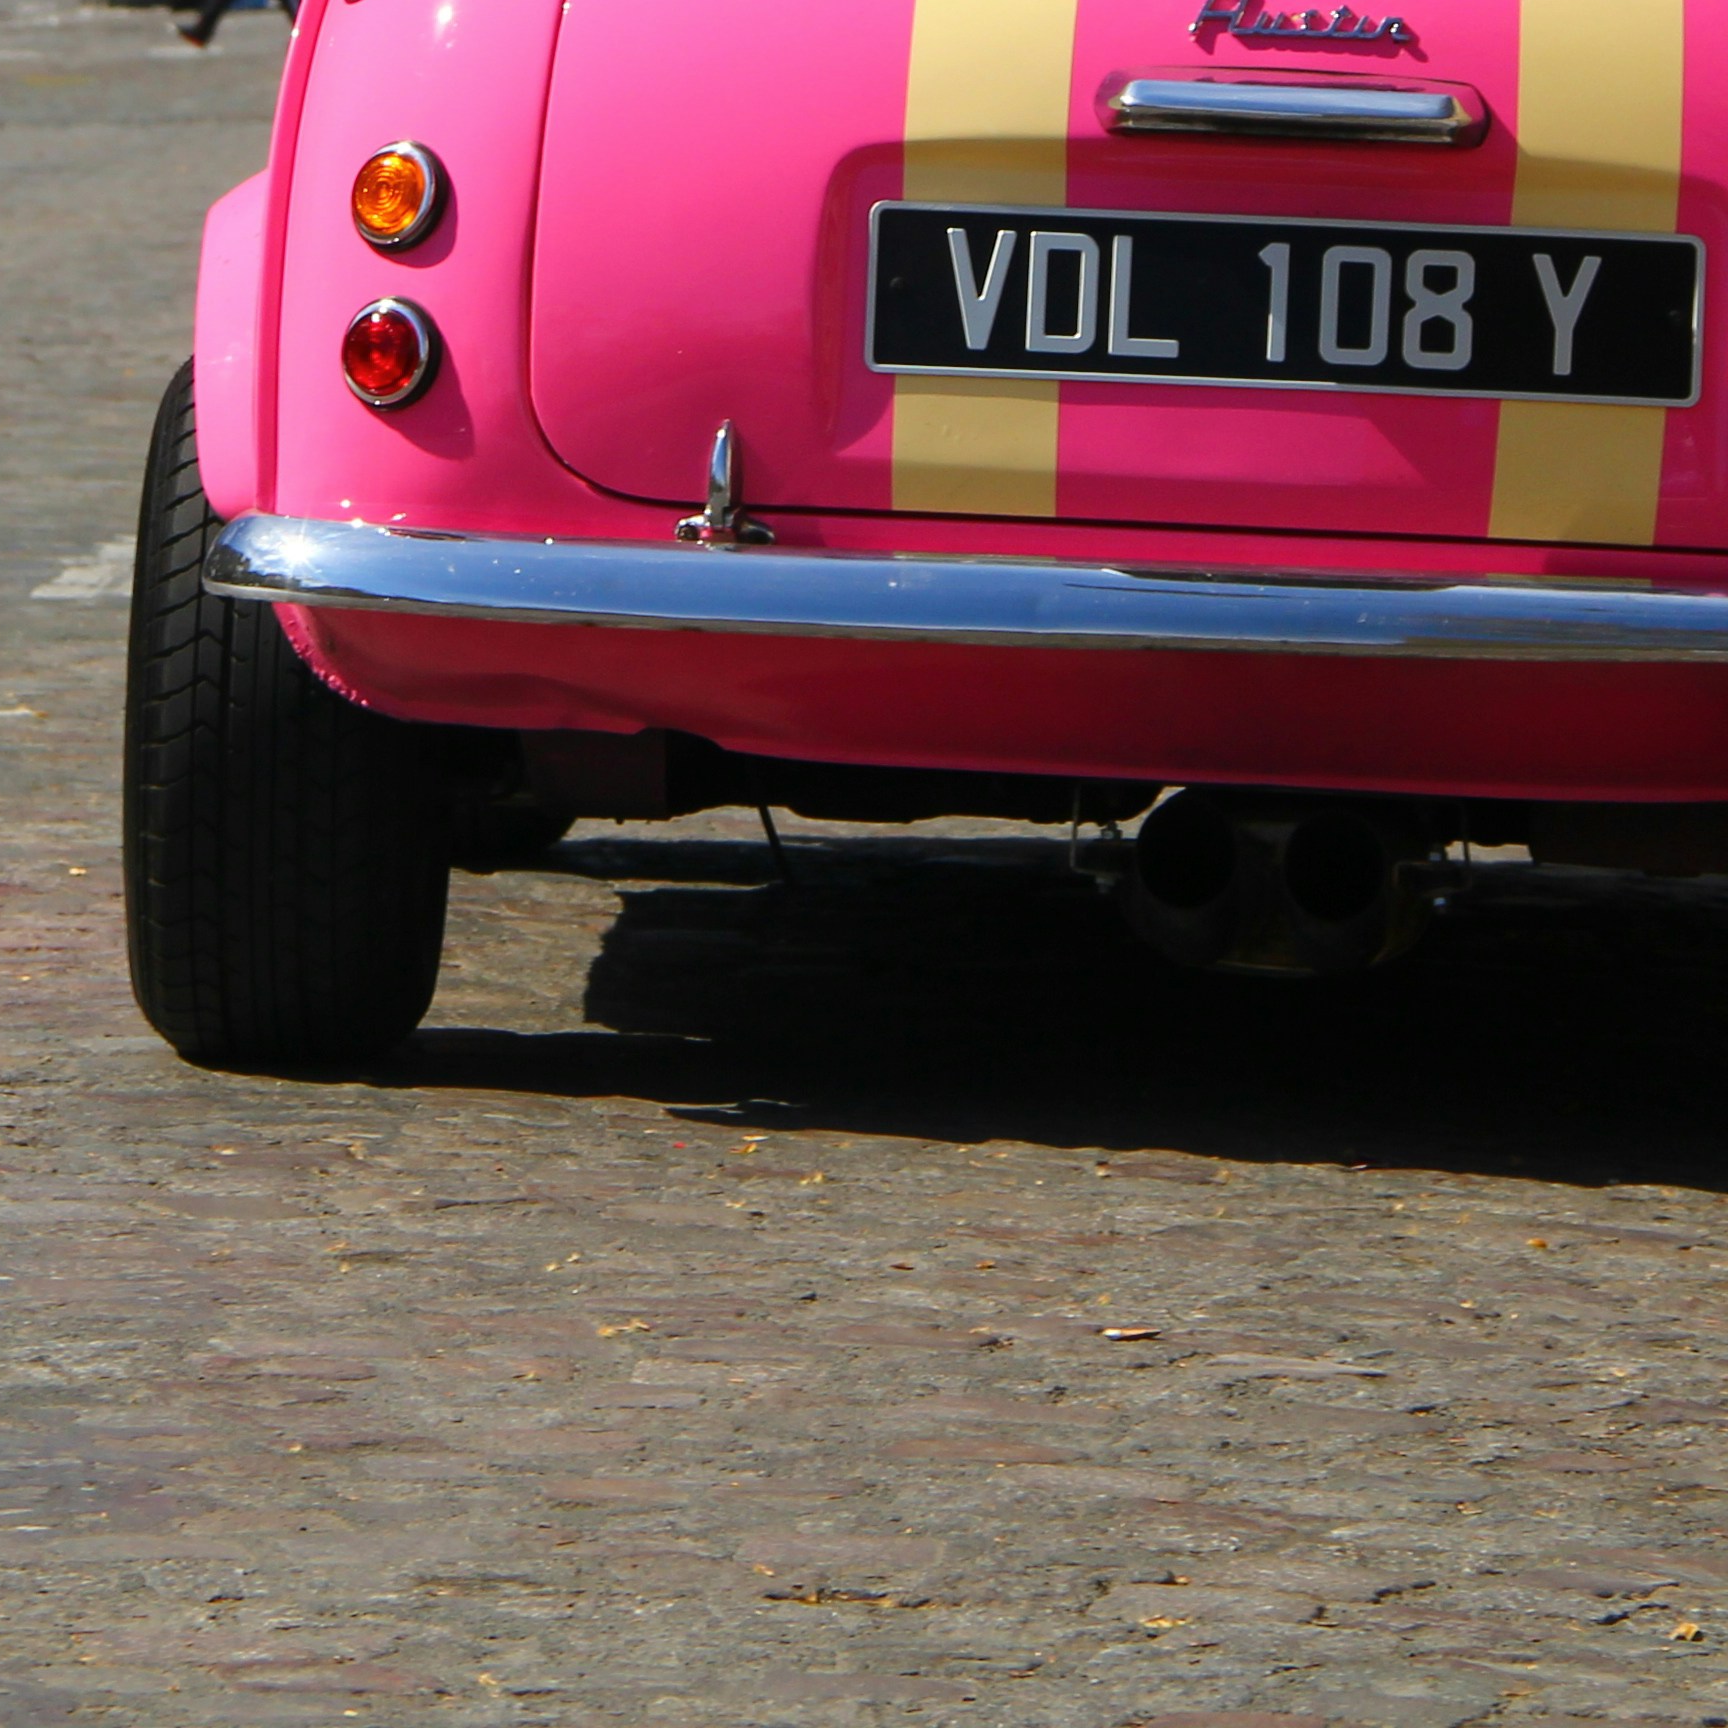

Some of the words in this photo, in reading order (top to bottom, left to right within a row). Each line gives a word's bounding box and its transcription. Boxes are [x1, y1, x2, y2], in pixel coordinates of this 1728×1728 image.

[946, 227, 1179, 359] VDL
[1259, 242, 1475, 370] 108
[1534, 253, 1603, 377] Y
